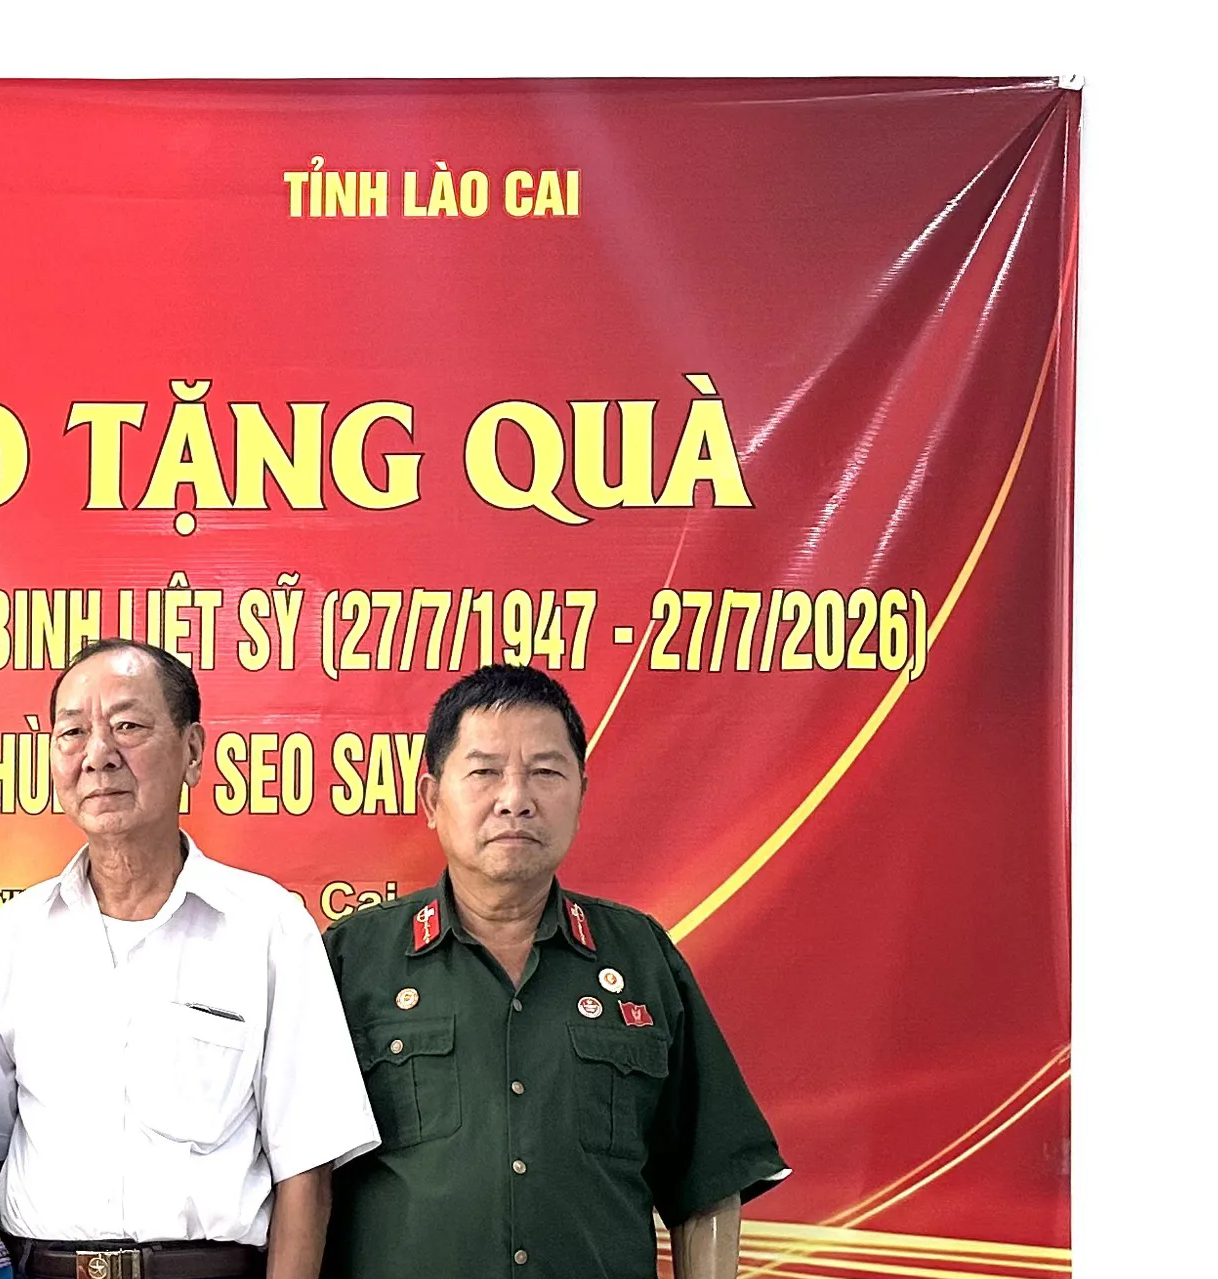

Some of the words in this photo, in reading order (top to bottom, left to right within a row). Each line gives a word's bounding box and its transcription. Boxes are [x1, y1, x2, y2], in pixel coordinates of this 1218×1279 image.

[284, 156, 387, 218] TỈNH
[403, 166, 490, 218] LÀO
[503, 171, 580, 218] CAI
[66, 378, 425, 536] TẶNG
[463, 373, 752, 525] QUÀ
[237, 570, 302, 671] SỸ
[322, 588, 596, 676] (27/7/1947
[613, 626, 633, 643] -
[648, 586, 929, 678] 27/7/2026)
[213, 731, 314, 816] SEO
[331, 731, 427, 816] SAY
